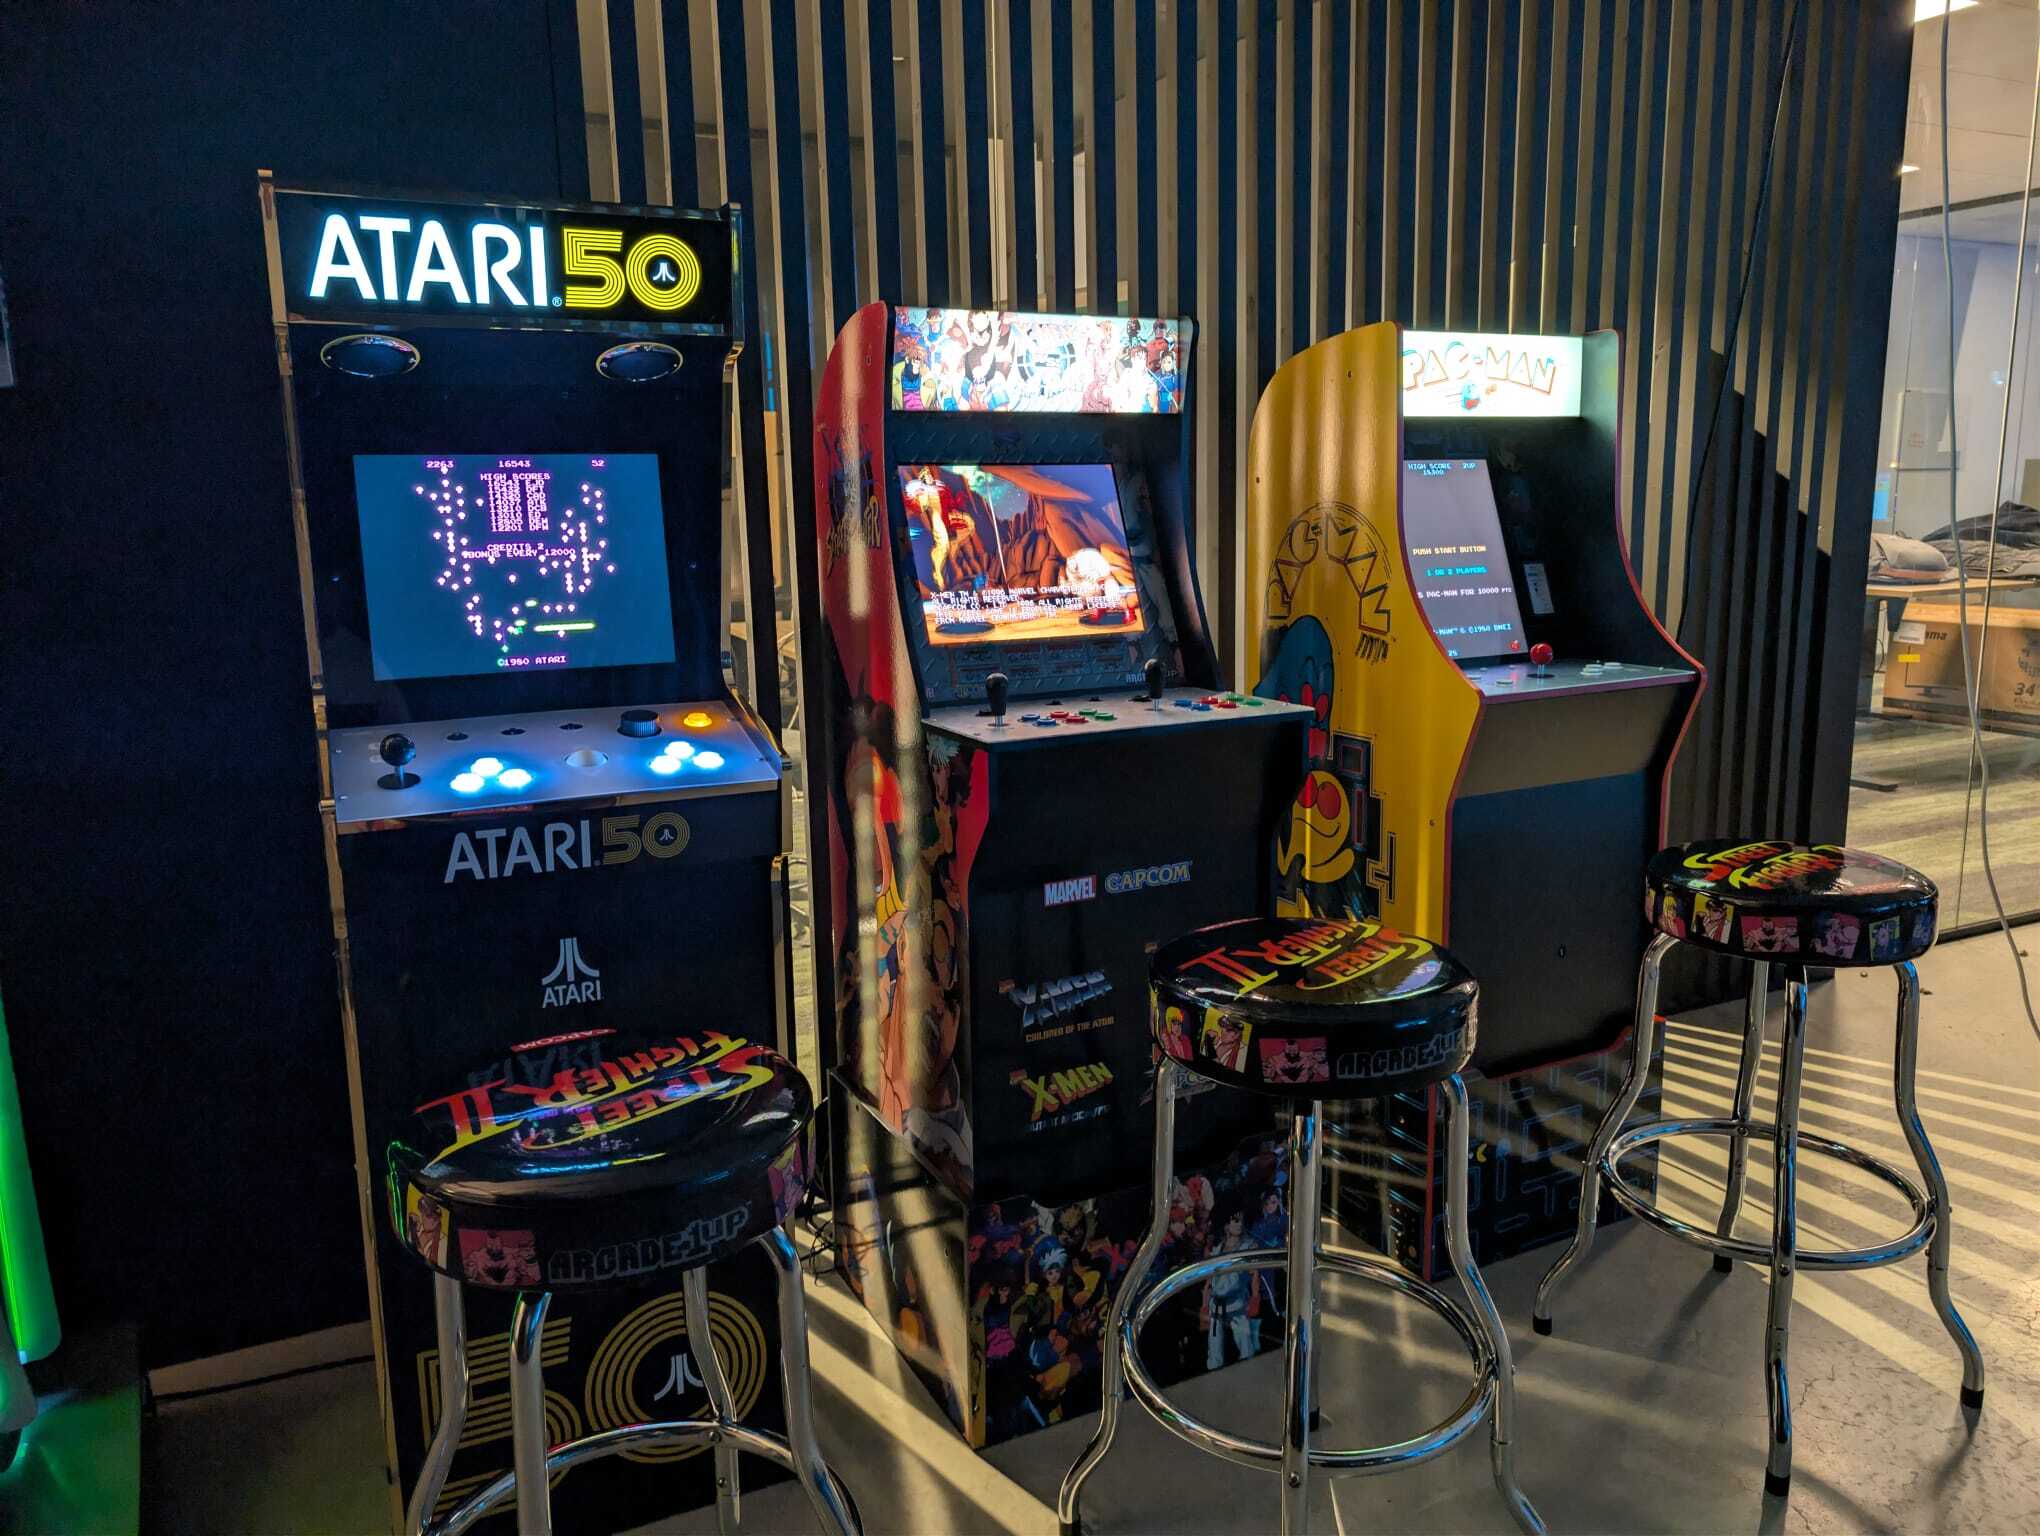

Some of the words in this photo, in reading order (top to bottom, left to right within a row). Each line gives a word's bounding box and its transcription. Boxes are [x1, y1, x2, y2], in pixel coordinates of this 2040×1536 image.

[308, 212, 549, 307] ATARI
[562, 226, 703, 311] 50
[498, 460, 531, 468] 16543
[591, 459, 605, 467] 52
[480, 473, 507, 481] HIGH
[512, 472, 550, 480] SCORES
[487, 543, 532, 552] CREDITS
[506, 549, 538, 557] EVERY
[544, 548, 576, 557] 12000
[535, 655, 567, 664] ATARI
[443, 818, 592, 884] ATARI
[601, 811, 691, 865] 50
[1105, 861, 1193, 894] CAPCOM
[1044, 876, 1096, 906] MARVEL
[541, 982, 602, 1009] ATARI
[1022, 1061, 1115, 1122] X-MEN
